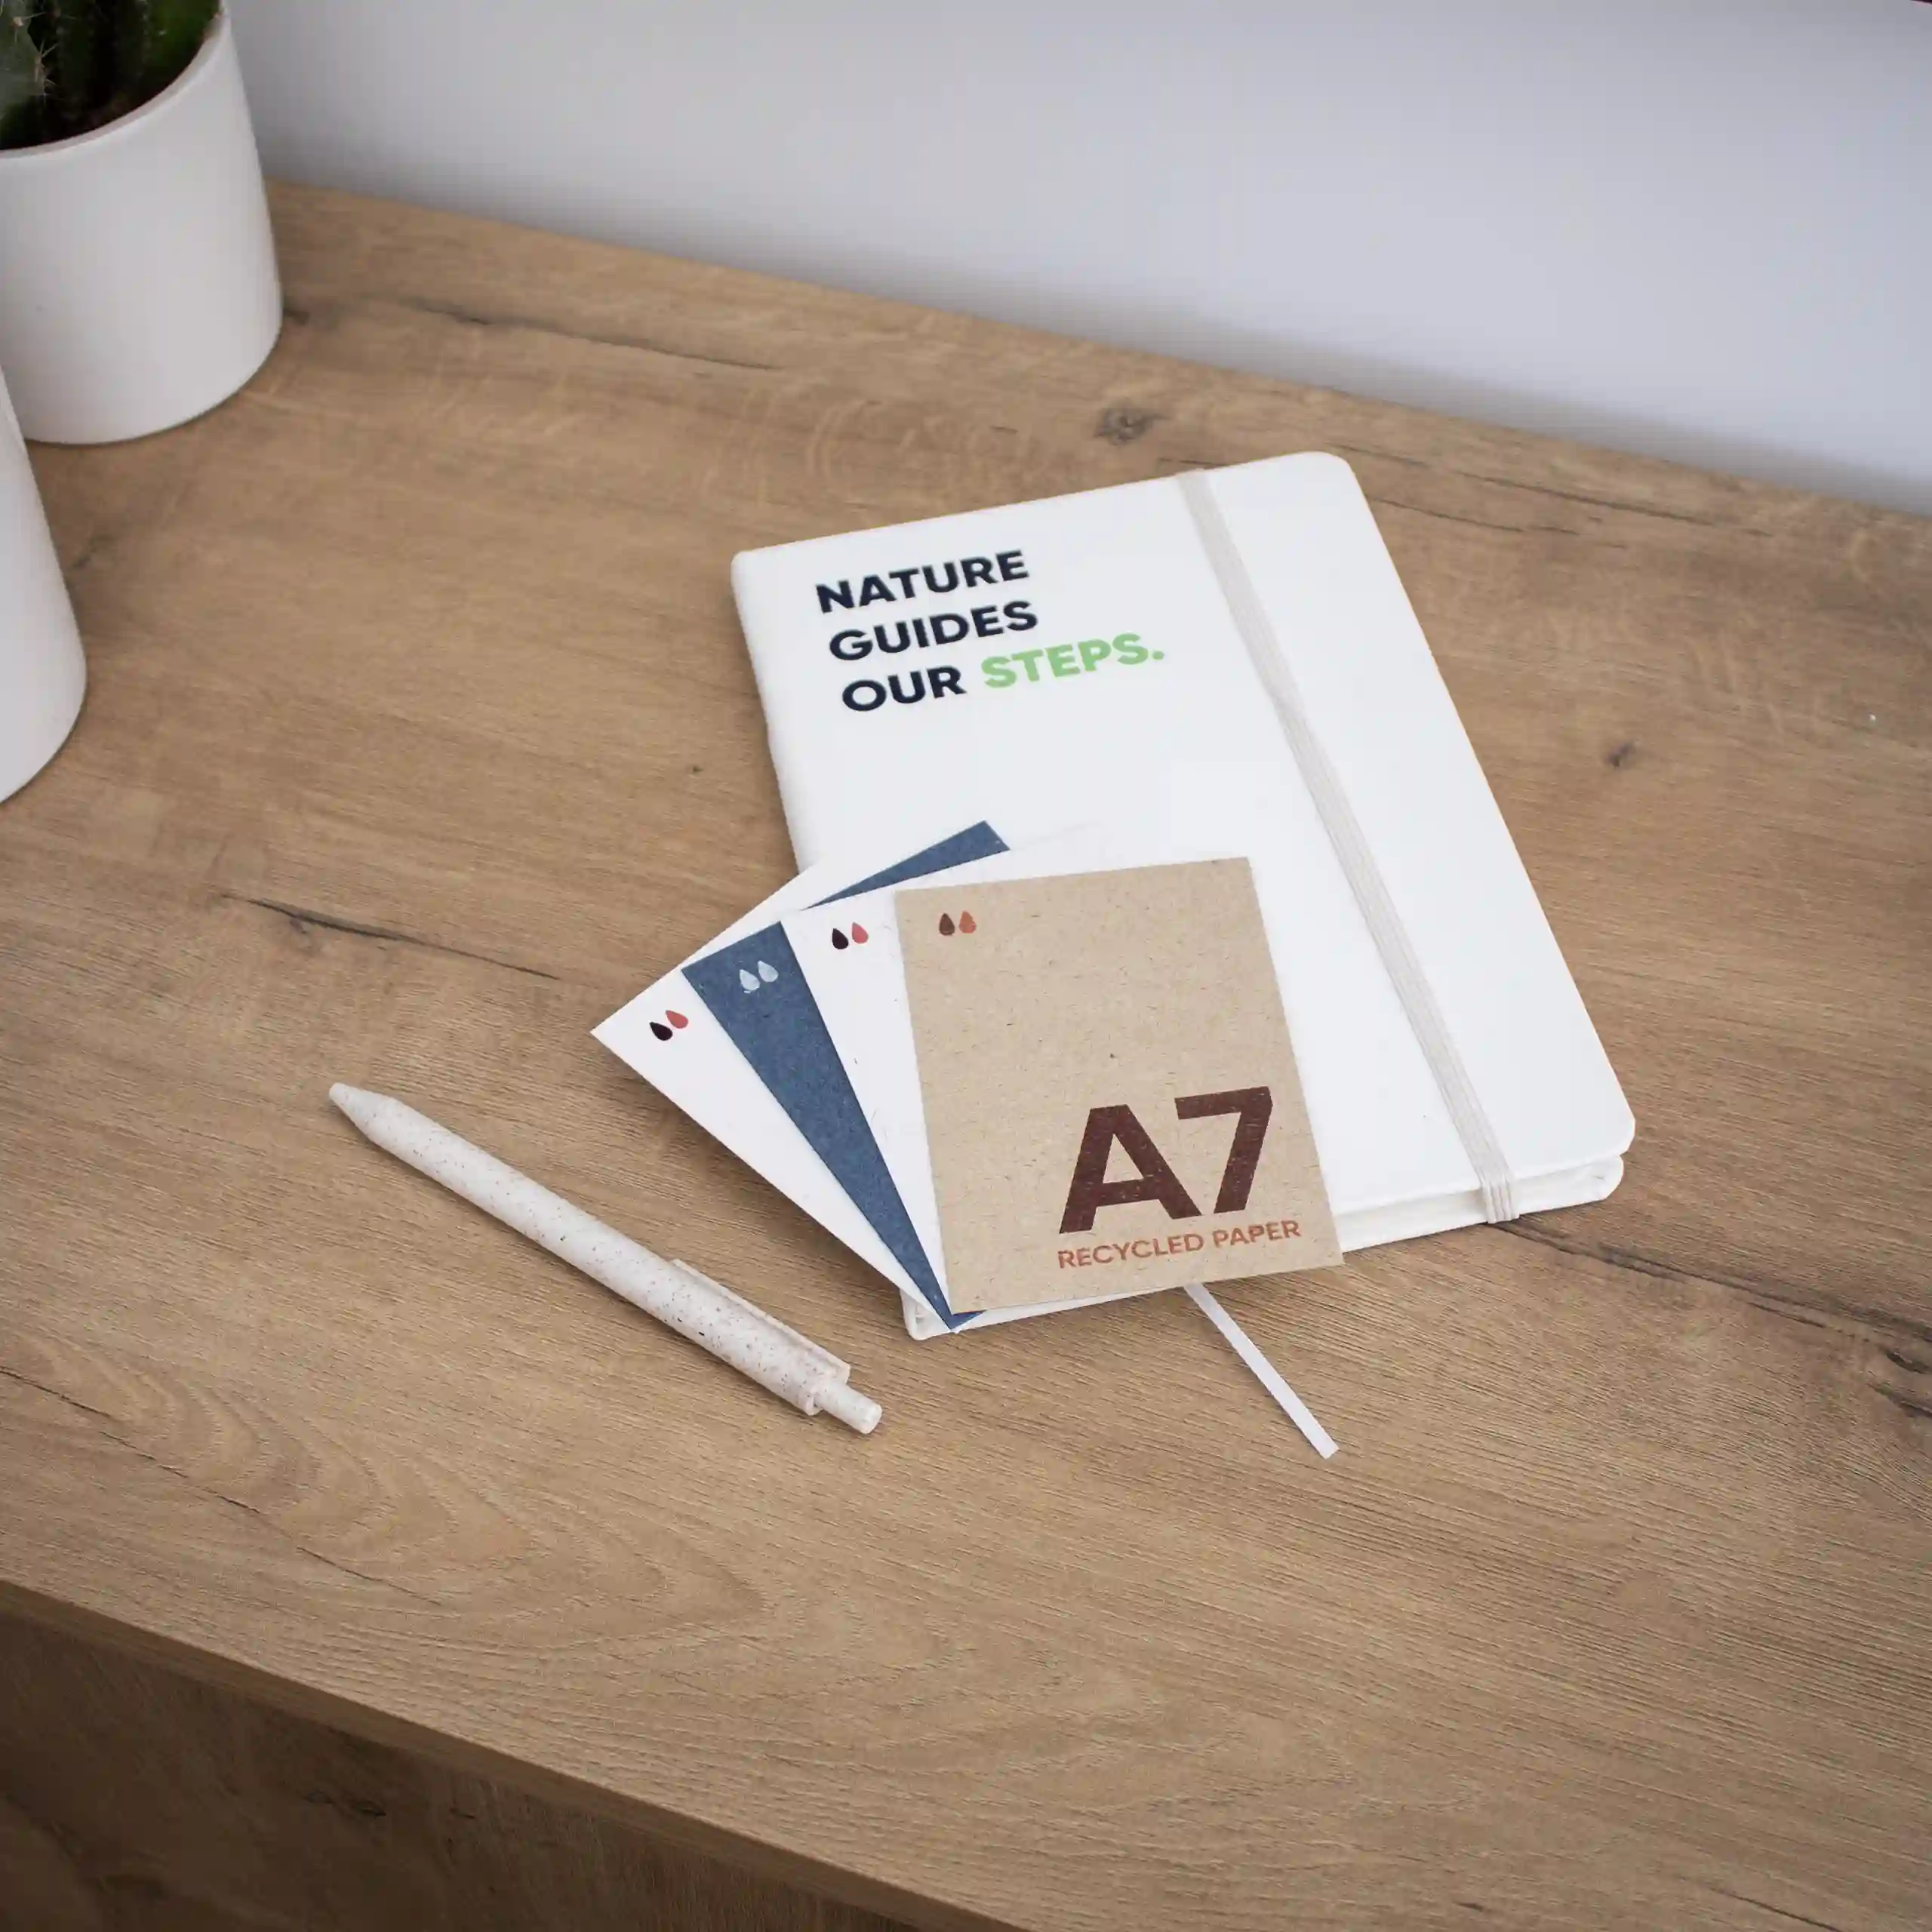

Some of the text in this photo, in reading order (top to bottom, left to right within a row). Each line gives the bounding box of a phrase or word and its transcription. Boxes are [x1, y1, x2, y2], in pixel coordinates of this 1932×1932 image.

[815, 549, 1029, 614] NATURE
[829, 601, 1038, 661] GUIDES
[842, 632, 1165, 712] OUR STEPS.
[1059, 1085, 1273, 1234] A7
[1057, 1220, 1302, 1269] RECYCLED PAPER
